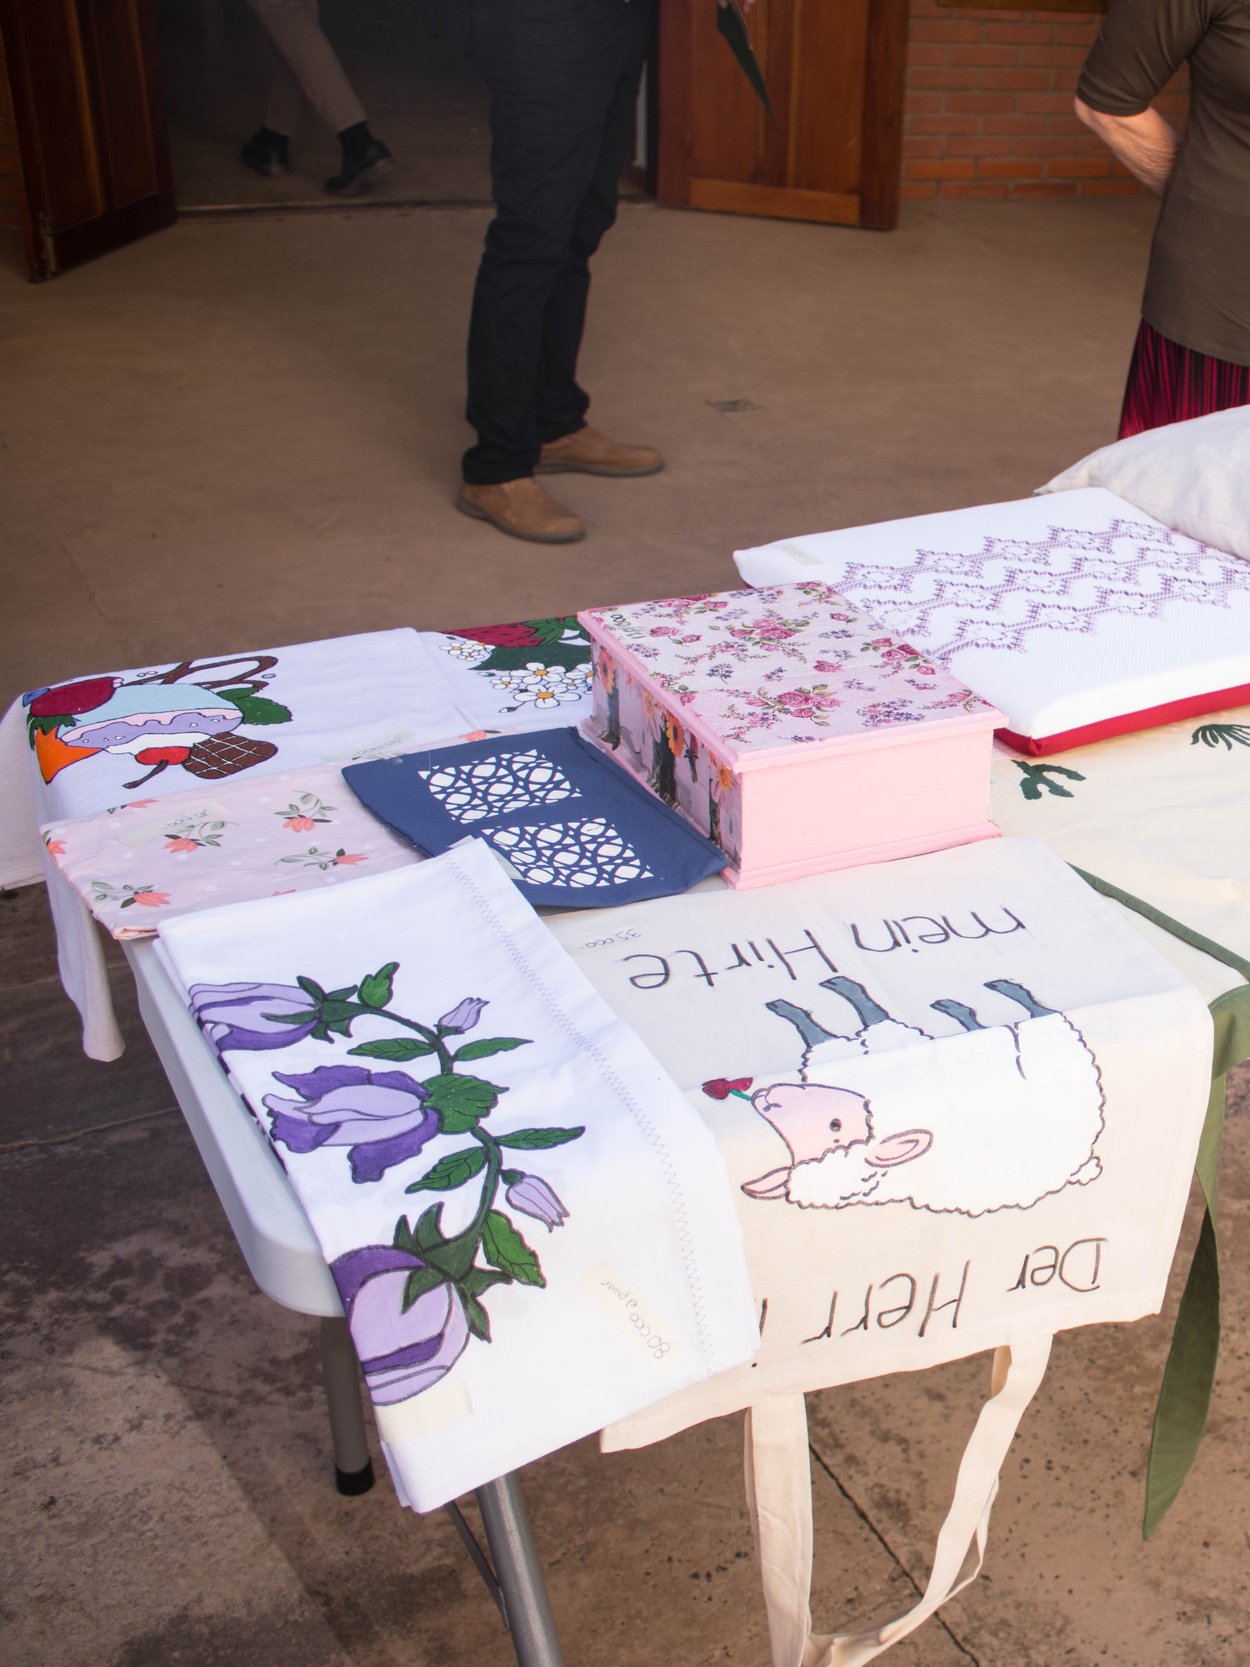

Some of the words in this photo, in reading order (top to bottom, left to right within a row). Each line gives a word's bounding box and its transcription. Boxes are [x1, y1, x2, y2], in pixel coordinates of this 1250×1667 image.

[849, 904, 1026, 954] mein
[620, 928, 839, 990] Hirte
[1006, 1237, 1108, 1292] Der
[799, 1258, 972, 1346] Herr
